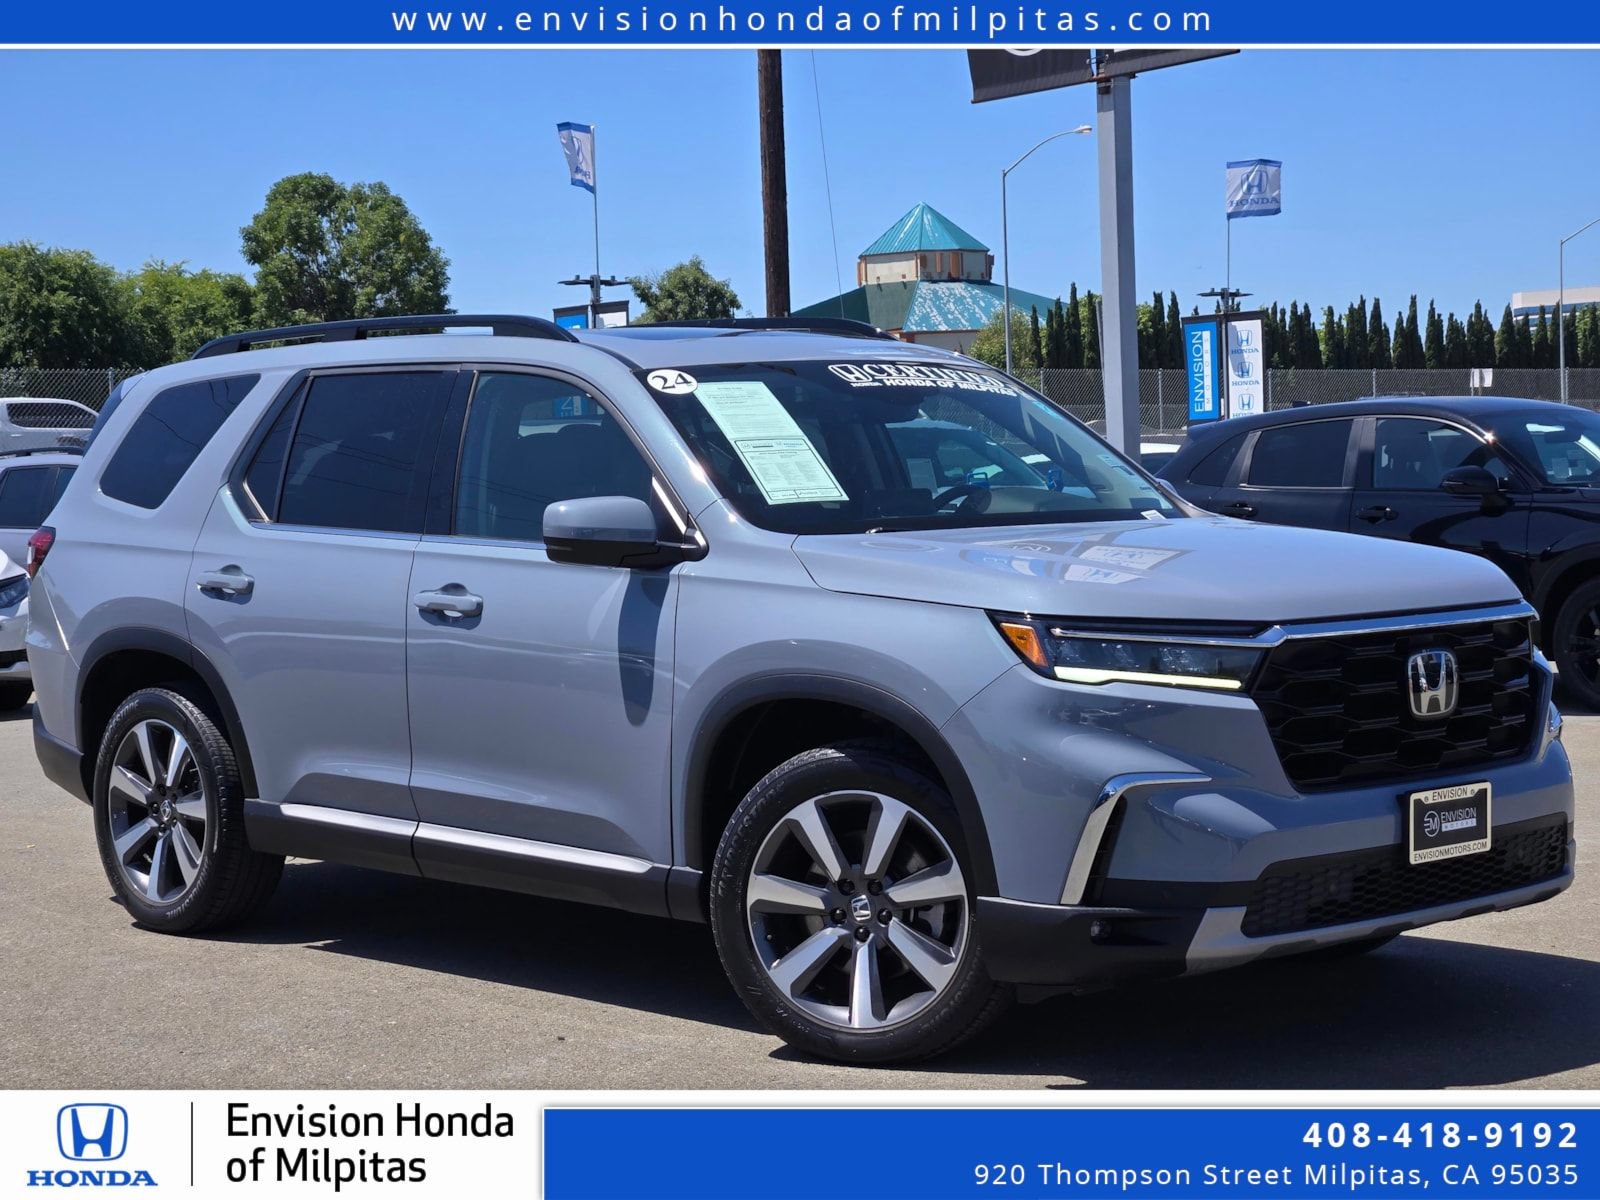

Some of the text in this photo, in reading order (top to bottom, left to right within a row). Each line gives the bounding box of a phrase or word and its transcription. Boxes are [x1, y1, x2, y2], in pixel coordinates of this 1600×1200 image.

[862, 364, 1005, 388] CERTIFIED
[1191, 331, 1204, 412] ENVISION
[651, 372, 692, 390] 24
[883, 378, 935, 387] HONDA
[936, 380, 955, 389] OF
[1432, 787, 1468, 801] ENVISION
[1441, 807, 1477, 823] ENVISION
[1413, 841, 1487, 862] ENVISIONMOTORS.COM
